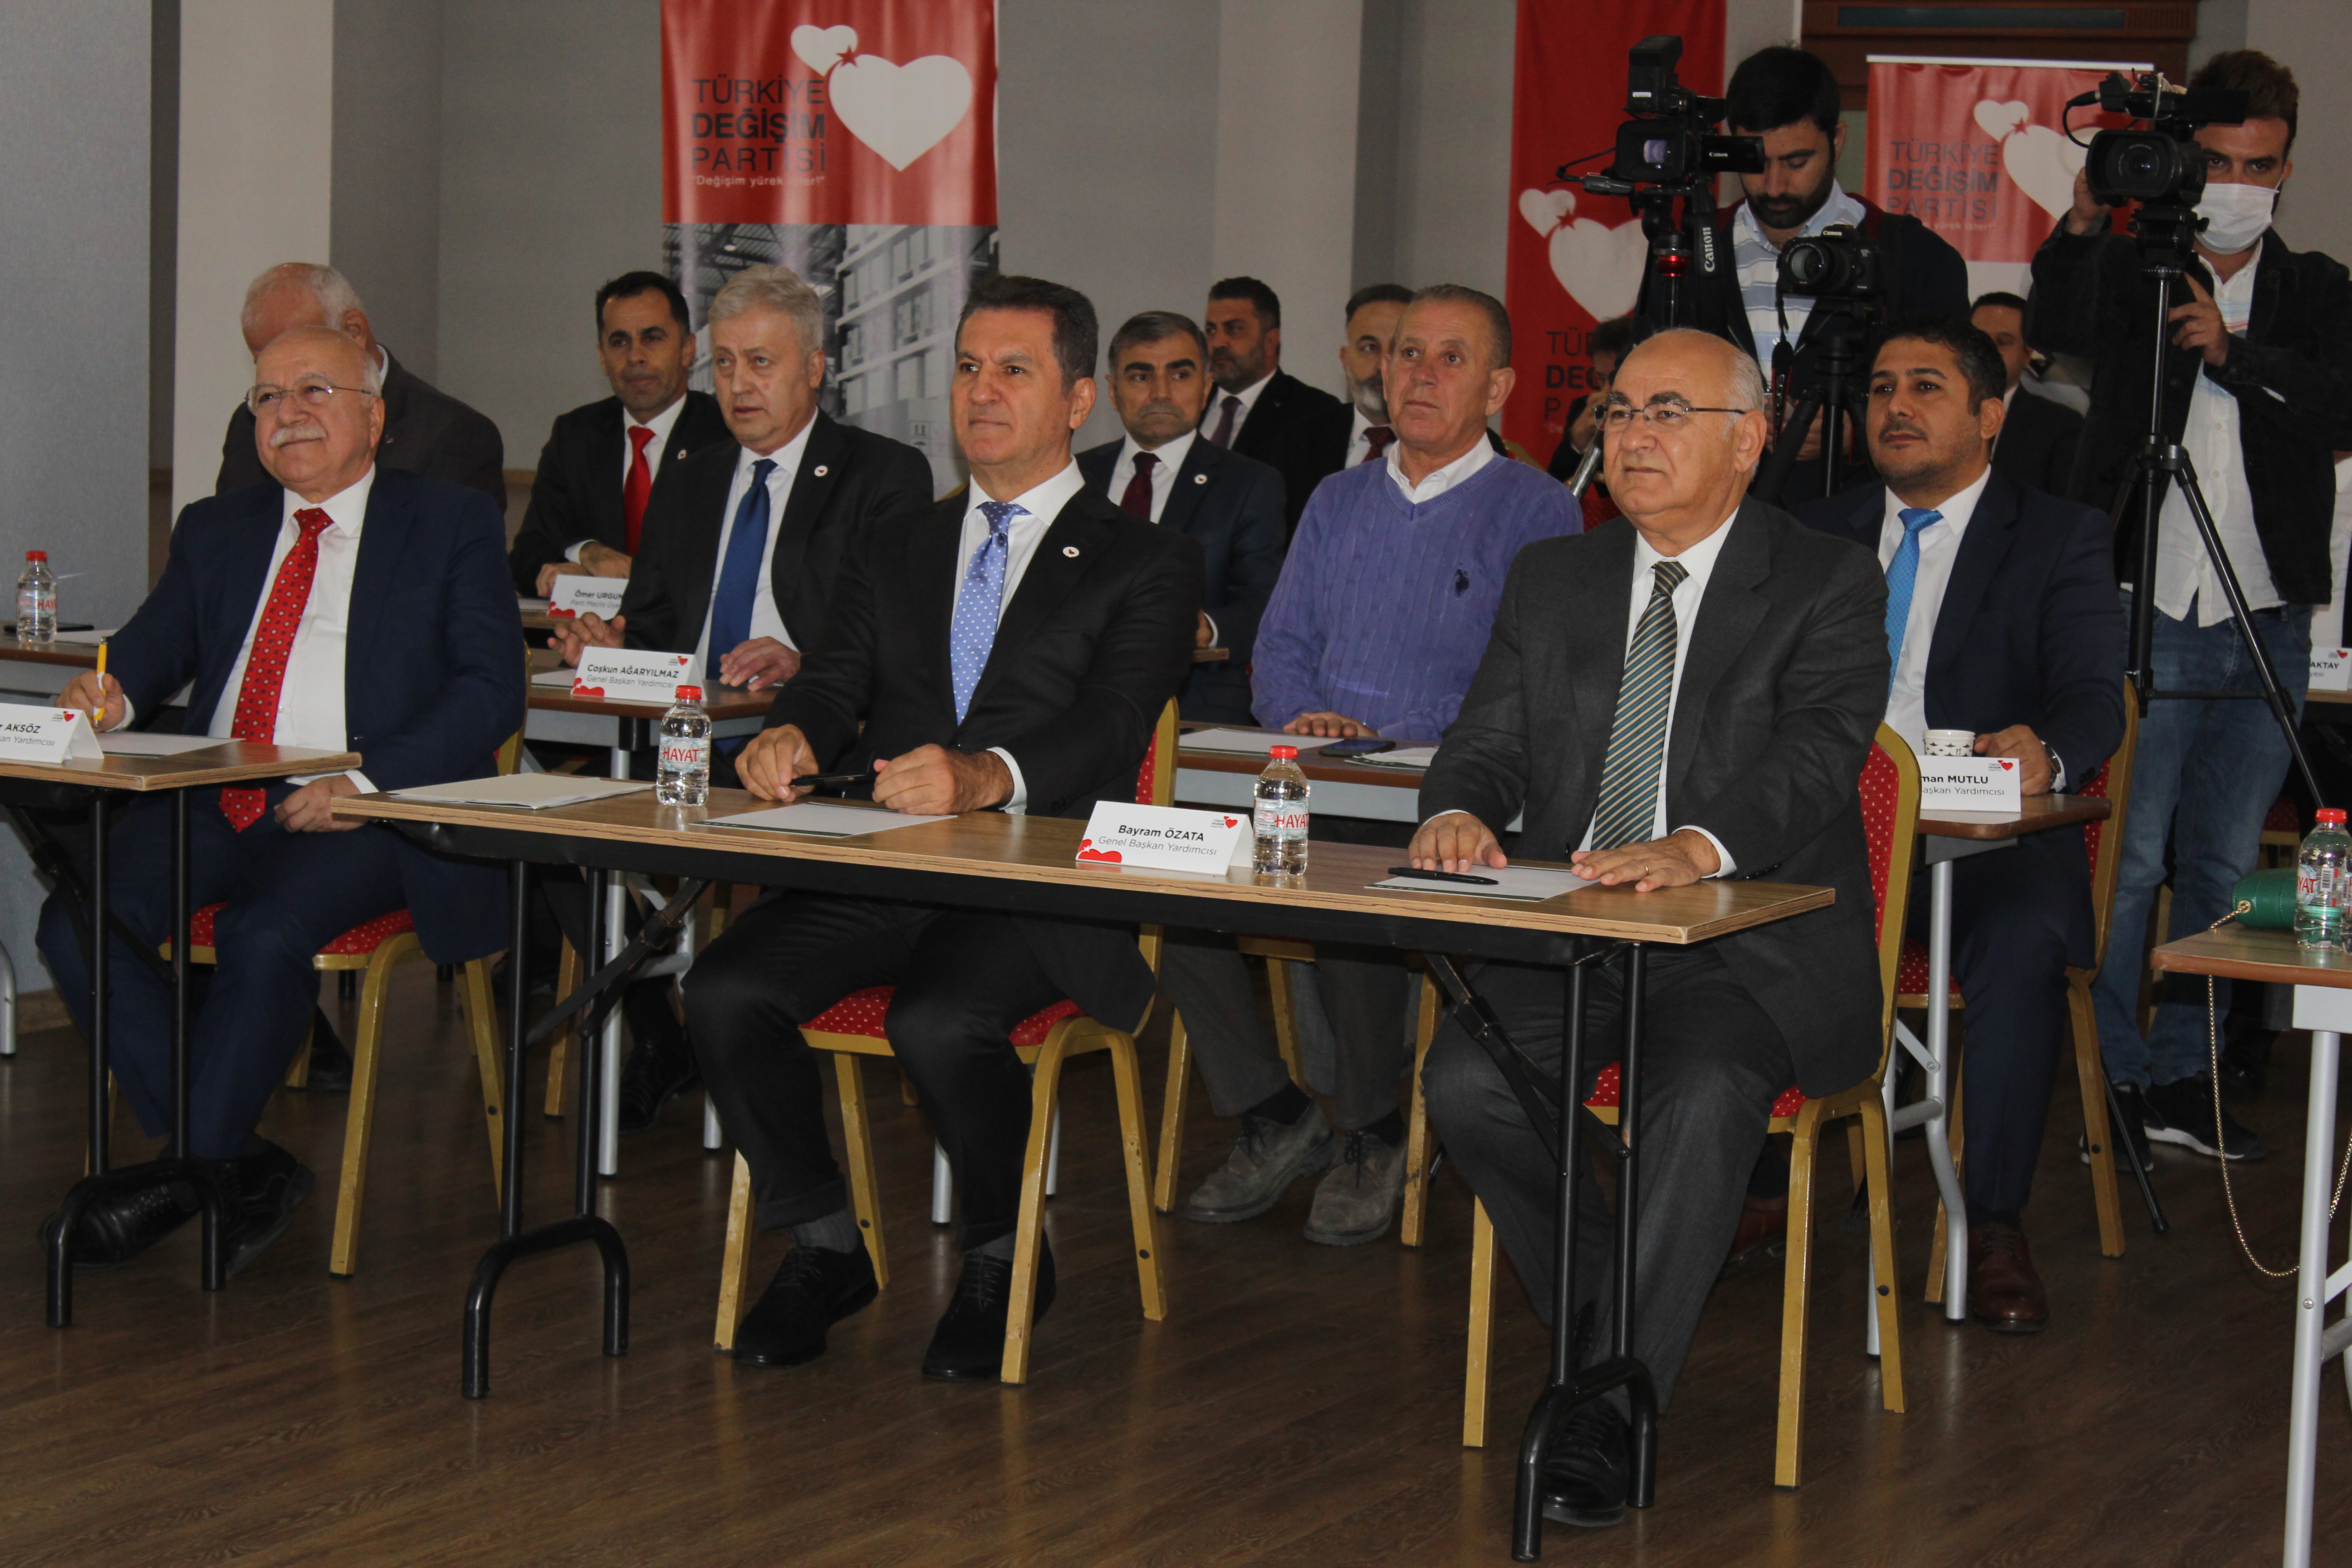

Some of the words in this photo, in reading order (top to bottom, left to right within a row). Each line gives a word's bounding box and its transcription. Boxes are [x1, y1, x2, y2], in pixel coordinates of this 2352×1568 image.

[692, 74, 824, 104] TÜRKİYE
[691, 108, 825, 143] DEĞİŞİM
[692, 143, 825, 172] PARTİSİ
[1891, 138, 1999, 165] TÜRKİYE
[750, 176, 783, 188] yürek
[1888, 166, 1999, 196] DEĞİŞİM
[1886, 195, 1997, 220] PARTİSİ
[1702, 227, 1715, 272] Canon
[574, 589, 595, 598] Ömer
[588, 664, 617, 673] Coşkun
[620, 666, 679, 678] AĞARYILMAZ
[609, 677, 635, 685] Başkan
[637, 679, 674, 688] Yardımcısı
[5, 723, 41, 734] AKSÖZ
[14, 736, 55, 746] Yardımcısı
[662, 747, 700, 762] HAYAT
[1948, 775, 1988, 784] MUTLU
[1954, 787, 2004, 795] Yardımcısı
[1274, 813, 1309, 829] HAYAT
[1118, 825, 1161, 837] Bayram
[1165, 828, 1204, 842] ÖZATA
[1098, 836, 1127, 847] Genel
[1128, 839, 1163, 851] Başkan
[1168, 843, 1217, 856] Yardımcısı
[2297, 876, 2318, 893] YAT
